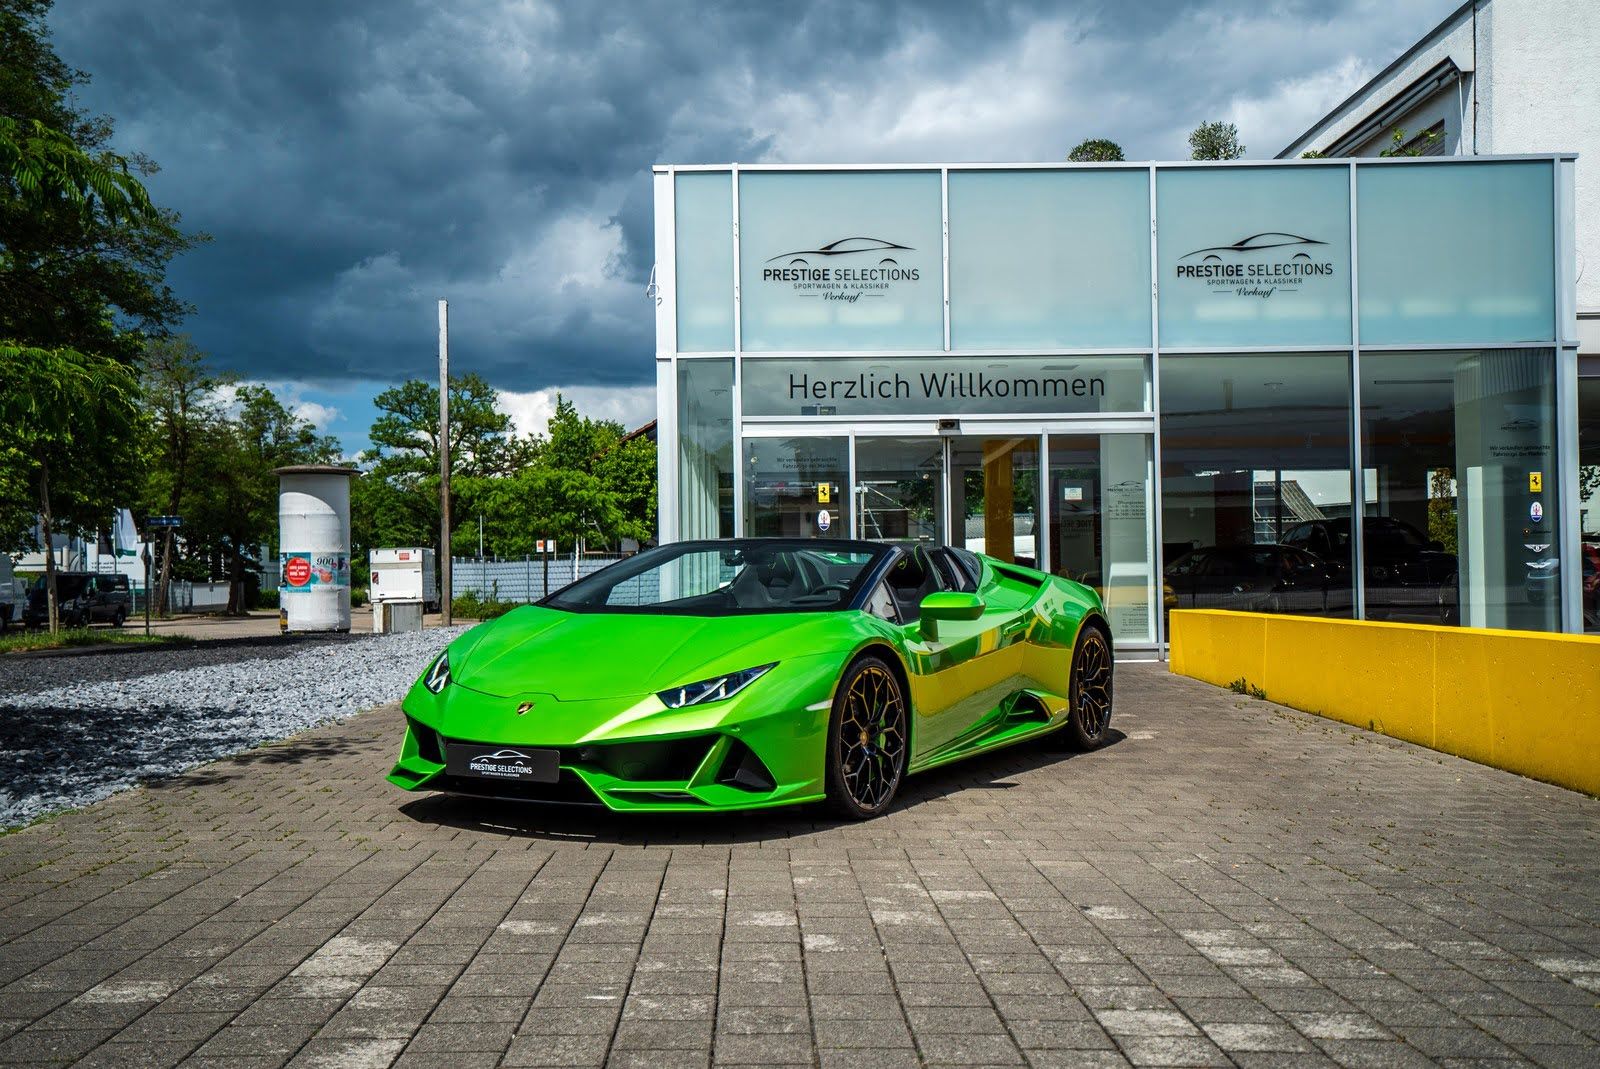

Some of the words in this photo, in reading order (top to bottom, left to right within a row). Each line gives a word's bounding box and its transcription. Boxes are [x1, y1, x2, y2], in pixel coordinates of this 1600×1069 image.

[763, 268, 831, 281] PRESTIGE
[834, 268, 920, 281] SELECTIONS
[1177, 264, 1244, 278] PRESTIGE
[1247, 263, 1333, 276] SELECTIONS
[1207, 278, 1255, 286] SPORTWAGEN
[1264, 277, 1303, 285] KLASSIKER
[822, 291, 864, 303] Verkauf
[1235, 286, 1277, 298] Verkauf
[789, 373, 910, 399] Herzlich
[920, 372, 1105, 398] Willkommen
[316, 557, 334, 566] 900
[470, 762, 497, 772] PRESTIGE
[497, 764, 533, 775] SELECTIONS
